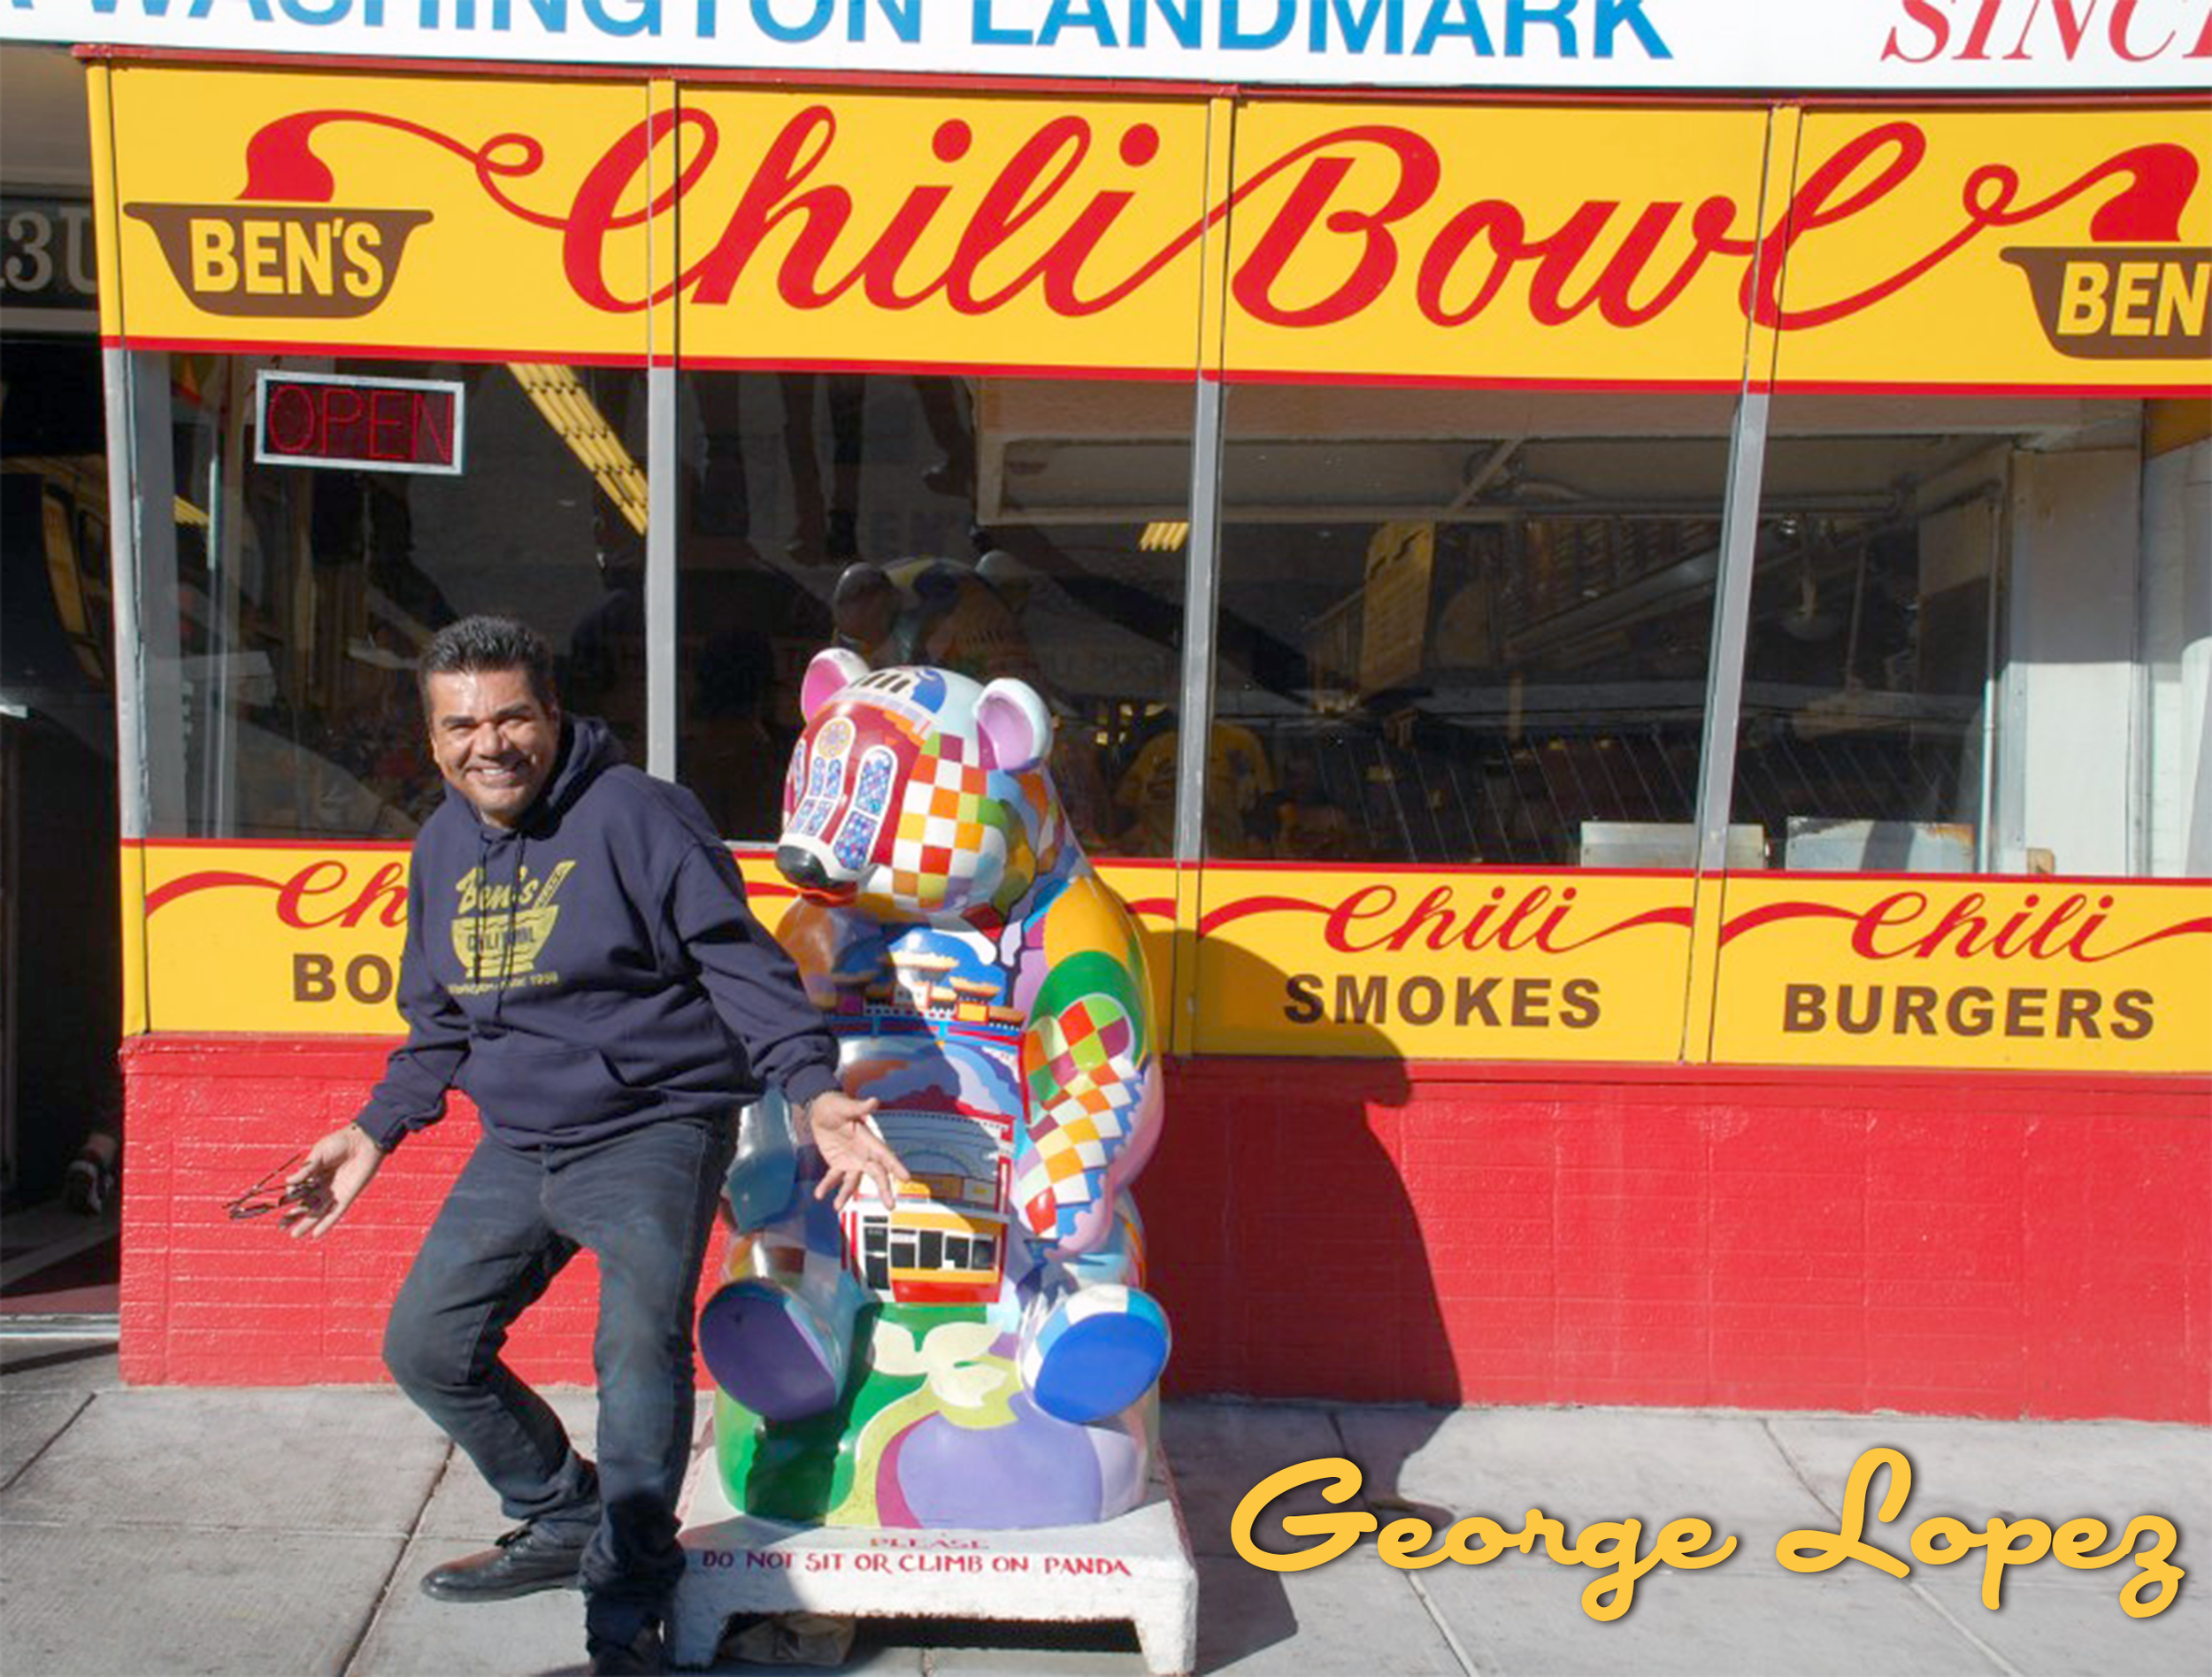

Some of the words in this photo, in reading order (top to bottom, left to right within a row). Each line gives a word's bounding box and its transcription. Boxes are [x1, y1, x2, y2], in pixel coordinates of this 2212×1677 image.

[972, 0, 1674, 59] LANDMARK
[1880, 0, 2212, 63] SINC
[563, 104, 1194, 319] Chili
[1232, 121, 1938, 332] Bowl
[189, 218, 384, 297] BEN'S
[2056, 261, 2212, 336] BEN
[268, 384, 455, 465] OPEN
[277, 859, 409, 929] Ch
[456, 865, 539, 914] Ben's
[1325, 885, 1586, 953] Chili
[1852, 892, 2120, 962] Chili
[293, 952, 394, 1004] BO
[1284, 973, 1601, 1029] SMOKES
[1783, 984, 2154, 1040] BURGERS
[702, 1550, 734, 1568] DO
[746, 1551, 794, 1569] NOT
[805, 1553, 842, 1572] SIT
[855, 1553, 892, 1573] OR
[899, 1554, 983, 1573] CLIMB
[992, 1556, 1028, 1573] ON
[1044, 1557, 1132, 1576] PANDA
